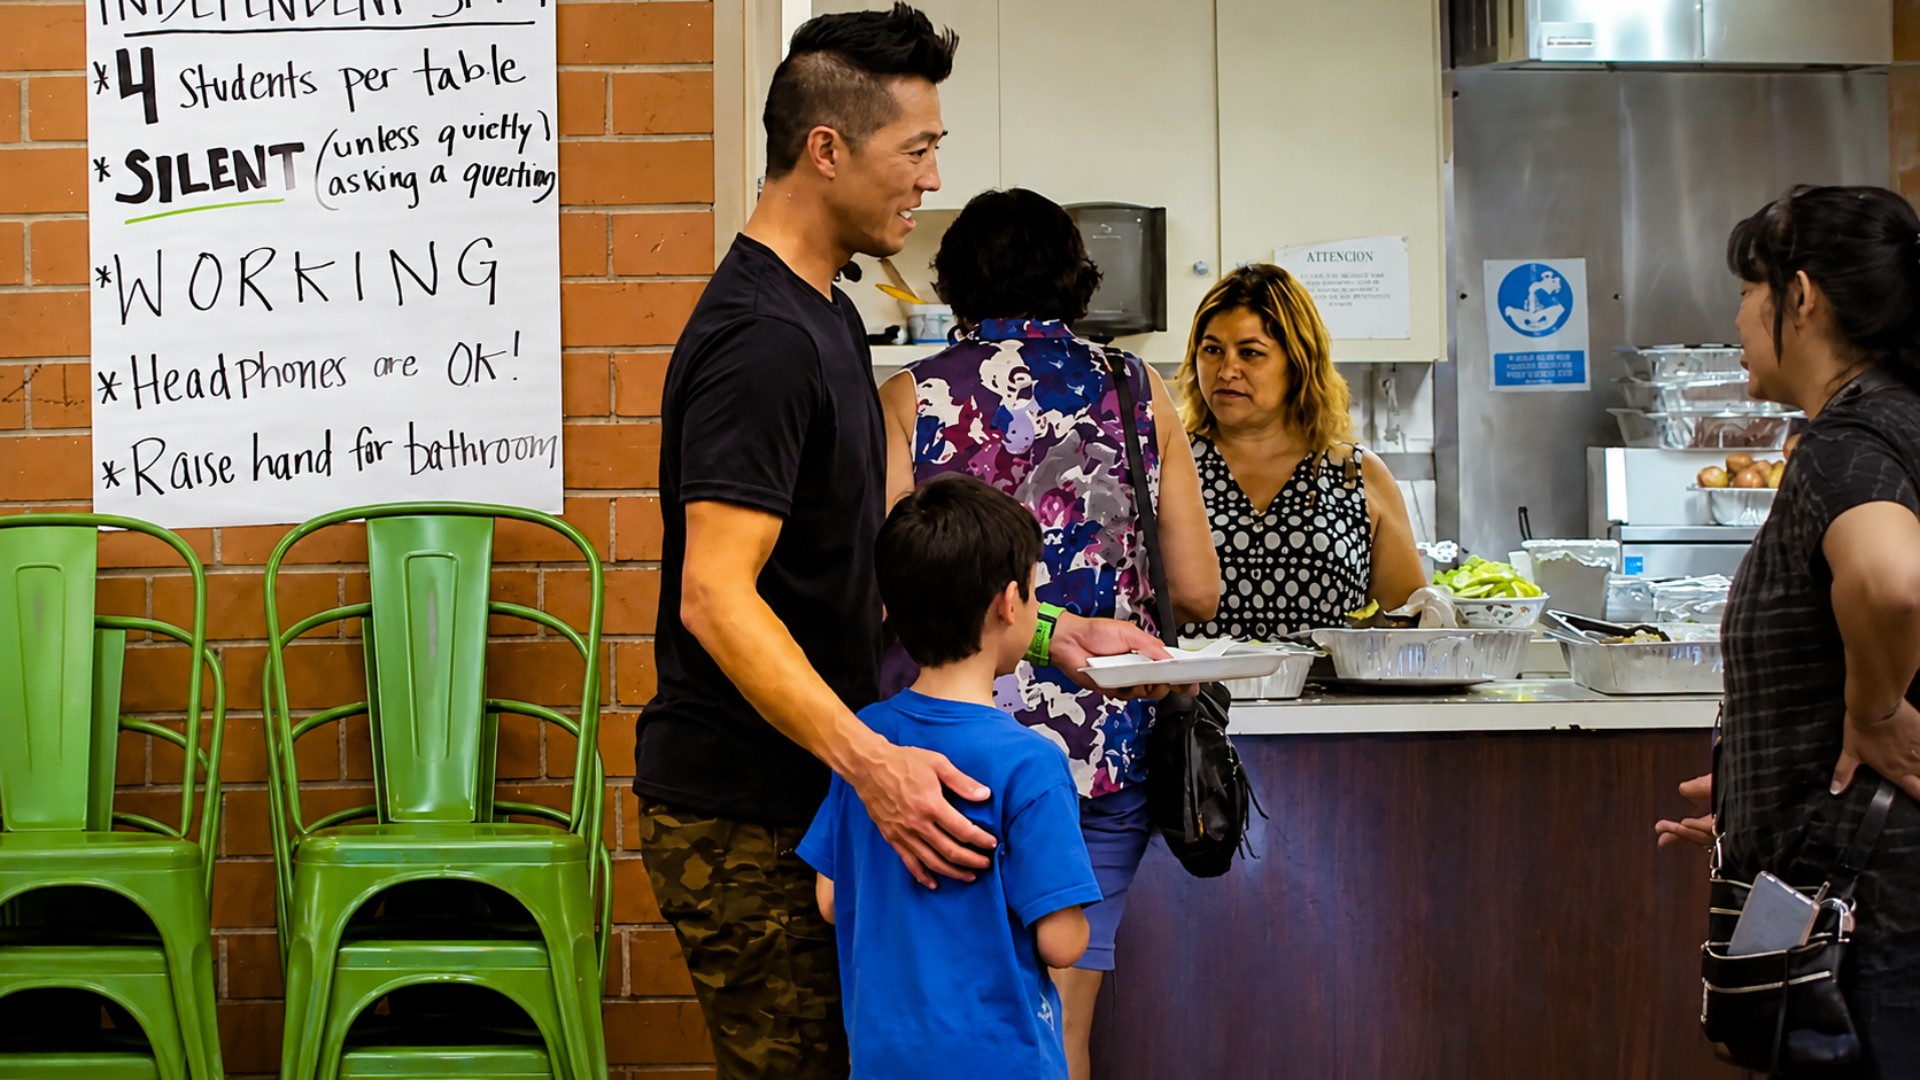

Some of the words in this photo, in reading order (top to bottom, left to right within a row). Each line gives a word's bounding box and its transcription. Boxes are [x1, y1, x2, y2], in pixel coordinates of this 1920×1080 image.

[116, 47, 158, 125] 4
[337, 67, 398, 113] per
[412, 44, 526, 96] table
[114, 141, 305, 203] SILENT
[329, 165, 419, 209] asking
[430, 164, 447, 183] a
[114, 237, 497, 325] WORKING
[373, 355, 418, 378] are
[448, 330, 520, 386] OK!
[131, 437, 235, 496] Raise
[252, 429, 331, 482] hand
[349, 426, 393, 471] for
[404, 421, 557, 475] bathroom
